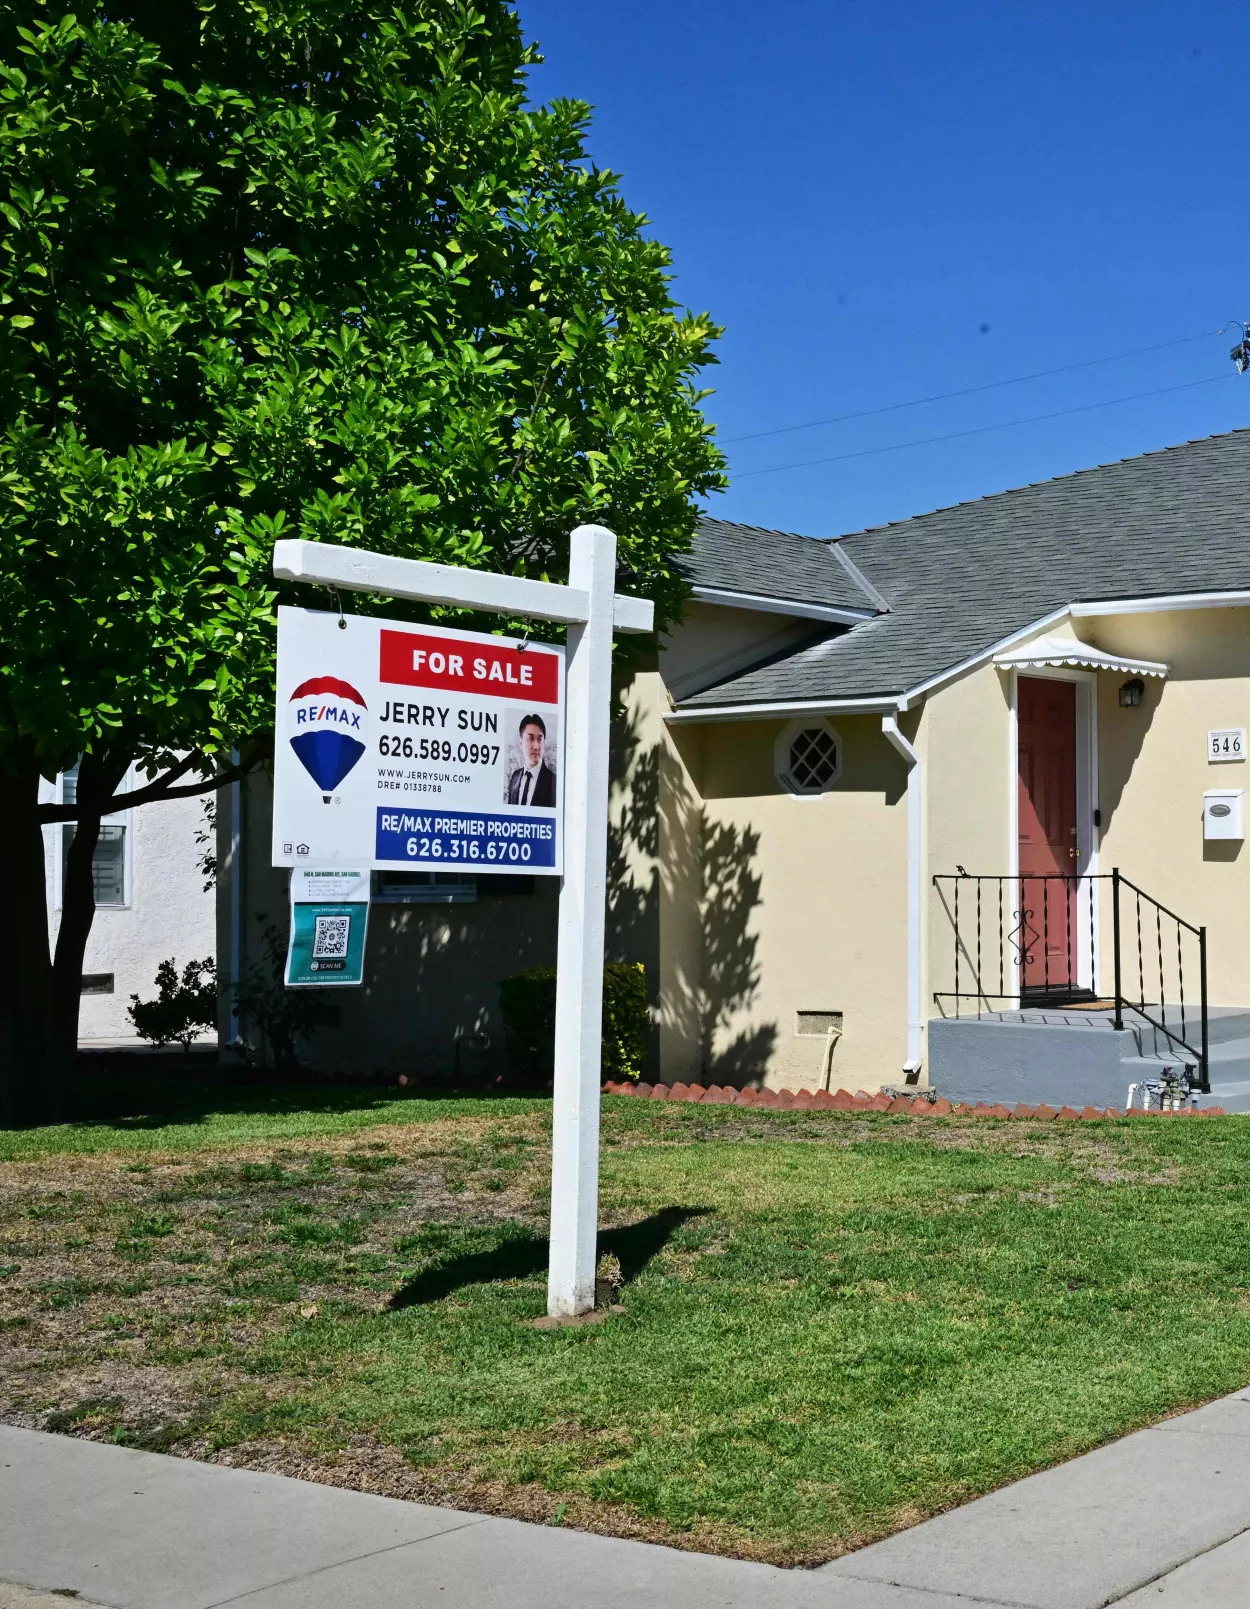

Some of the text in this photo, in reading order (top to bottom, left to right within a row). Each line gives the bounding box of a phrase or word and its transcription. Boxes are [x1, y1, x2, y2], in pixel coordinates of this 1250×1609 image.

[413, 649, 533, 686] FOR SALE
[297, 705, 361, 730] RE/MAX
[379, 701, 498, 733] JERRY SUN
[379, 734, 500, 765] 626.589.0997
[1212, 737, 1240, 753] 546
[377, 768, 471, 783] WWW.JERRYSUN.COM
[377, 780, 442, 793] DRE# 01338788
[381, 813, 553, 840] RE/MAX PREMIER PROPERTIES
[406, 837, 531, 861] 626.316.6700
